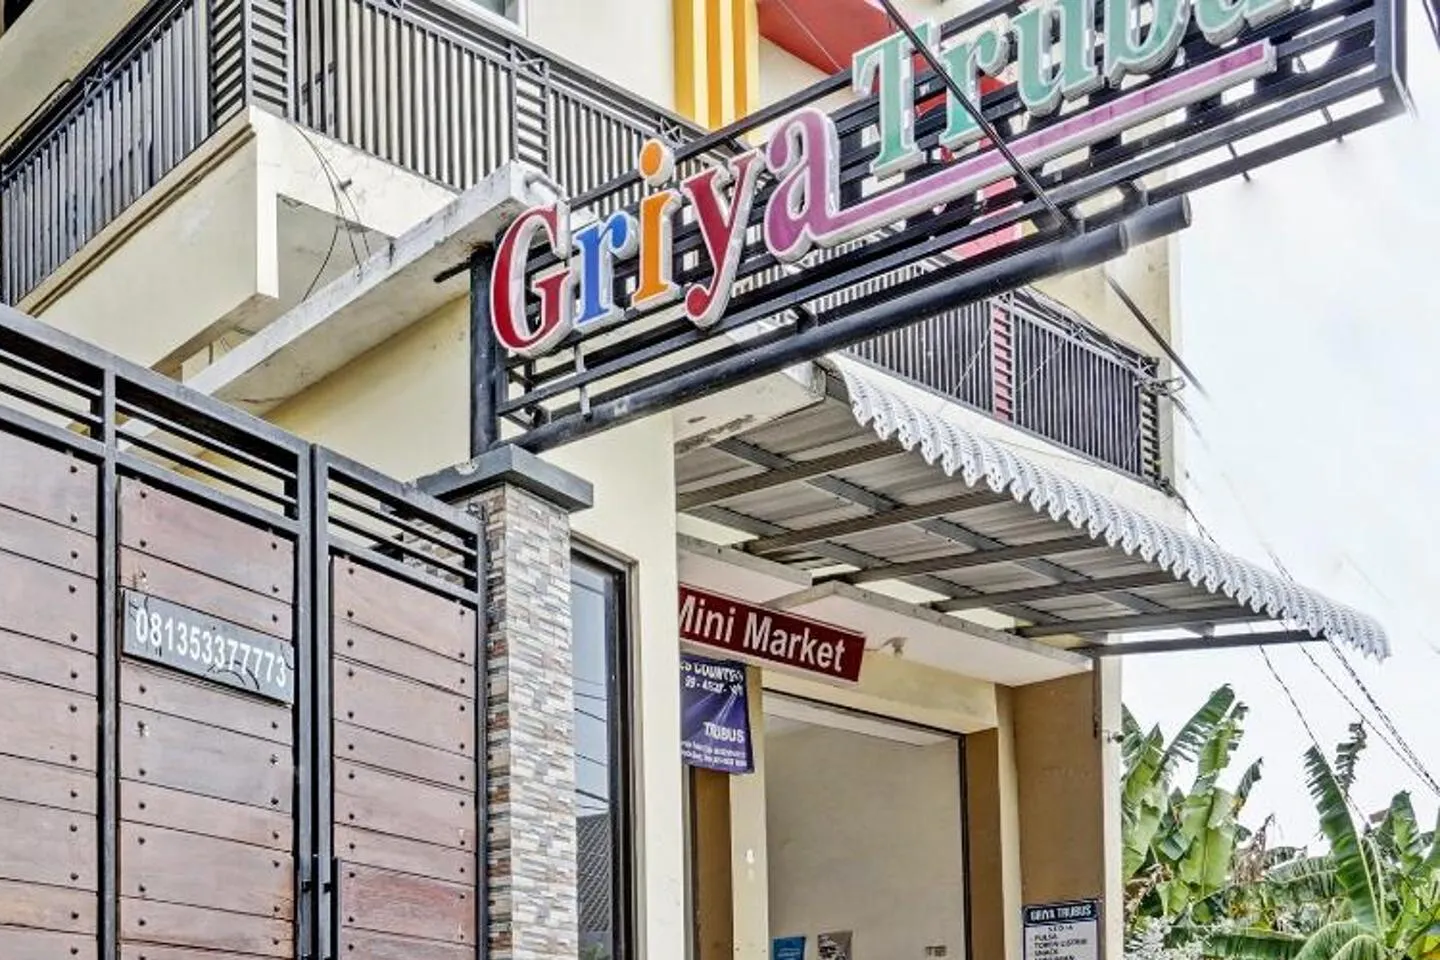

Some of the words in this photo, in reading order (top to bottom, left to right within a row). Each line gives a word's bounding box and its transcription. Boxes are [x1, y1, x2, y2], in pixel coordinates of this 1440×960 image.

[491, 108, 840, 354] Griya
[852, 0, 1290, 176] Trub
[135, 608, 287, 688] 081353377773
[743, 611, 846, 672] Market
